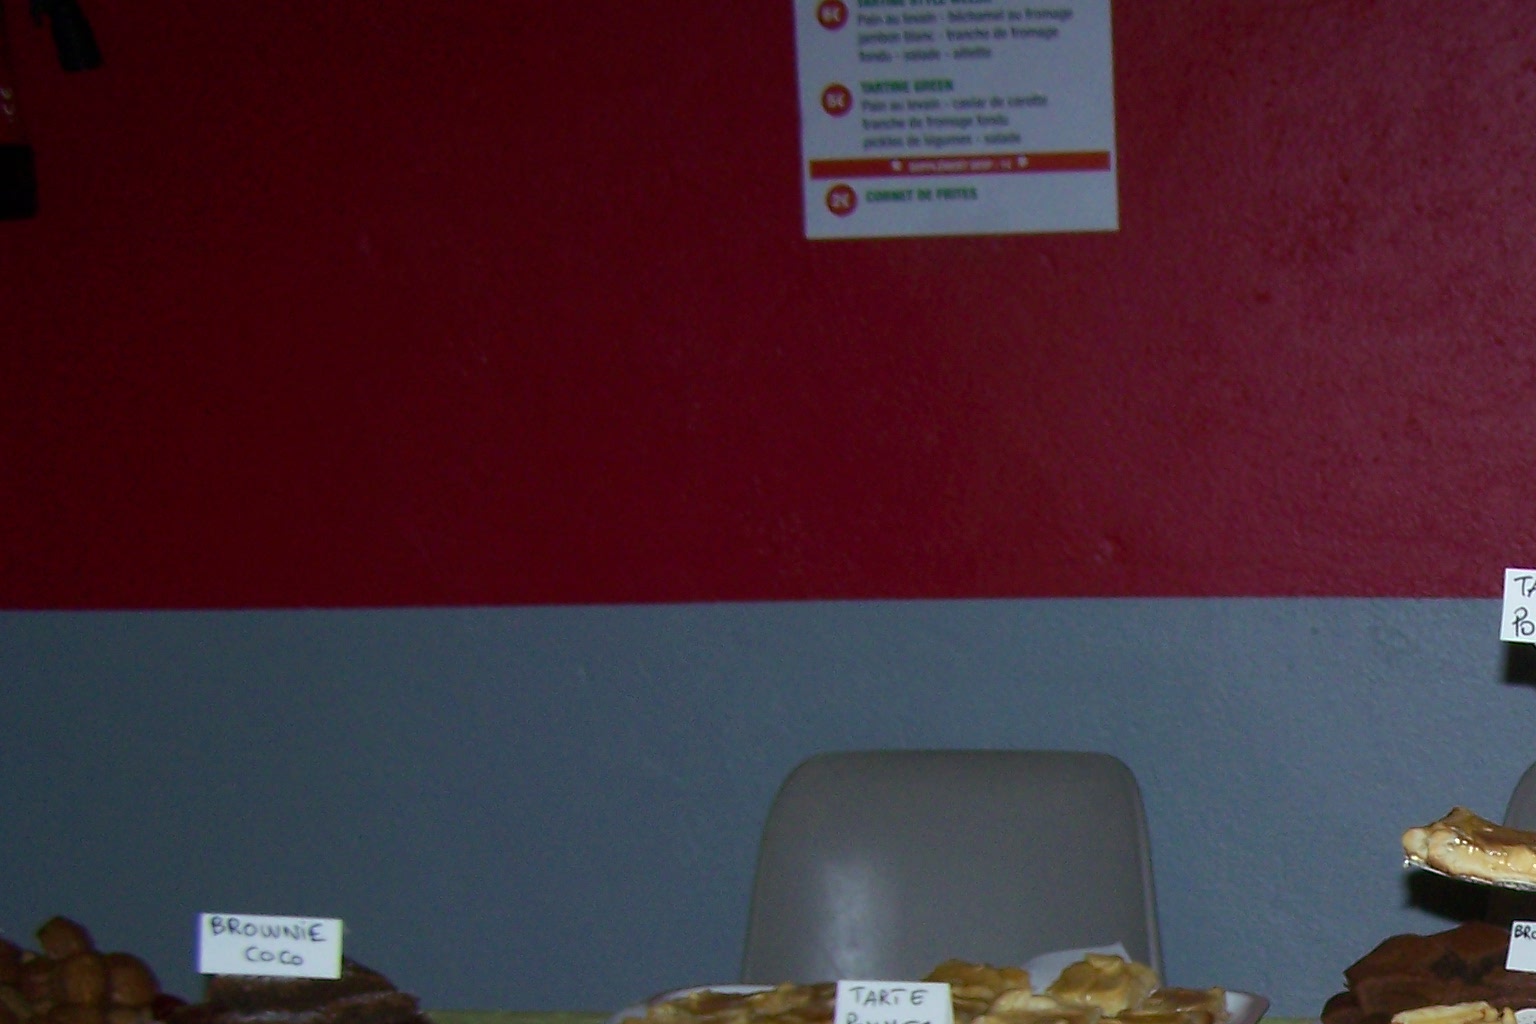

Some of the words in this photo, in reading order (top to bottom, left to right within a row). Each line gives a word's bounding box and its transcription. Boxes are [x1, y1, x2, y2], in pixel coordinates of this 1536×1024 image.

[1011, 26, 1059, 40] fromage
[860, 80, 909, 93] TARTINE
[914, 79, 953, 92] GREEN
[865, 189, 912, 202] CORNET
[917, 188, 932, 201] DE
[936, 187, 977, 200] FRITES
[849, 986, 929, 1006] TARTE
